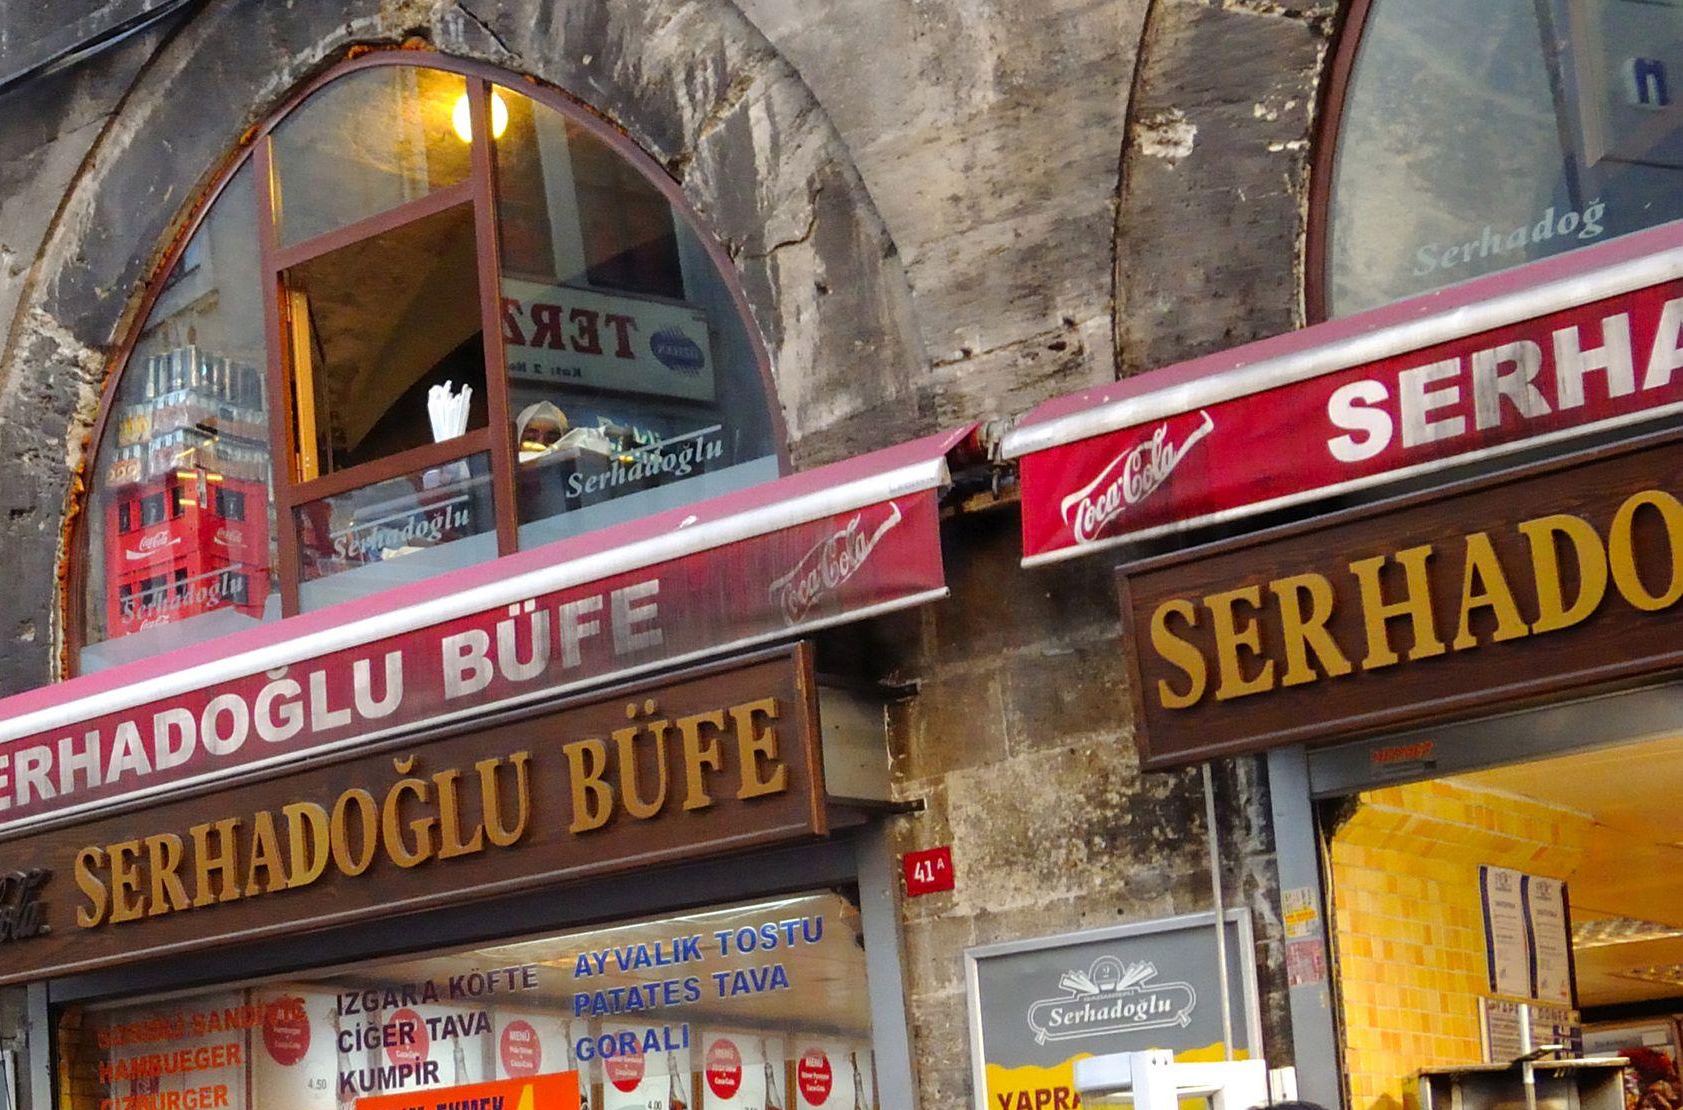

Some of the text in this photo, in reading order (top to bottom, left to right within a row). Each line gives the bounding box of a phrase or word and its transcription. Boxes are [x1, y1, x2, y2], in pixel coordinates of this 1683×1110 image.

[1061, 410, 1215, 545] Coca-Cola
[441, 579, 664, 701] BÜFE
[74, 697, 790, 929] SERHADOĞLU BÜFE
[573, 916, 824, 979] AYVALIK TOSTU
[337, 963, 539, 1017] IZGARA KÖFTE
[574, 963, 790, 1018] PATATES TAVA
[1048, 993, 1172, 1028] Serhadoğlu
[337, 1010, 492, 1054] CİĞER TAVA
[575, 1023, 690, 1063] GORALI
[339, 1056, 441, 1095] KUMPİR
